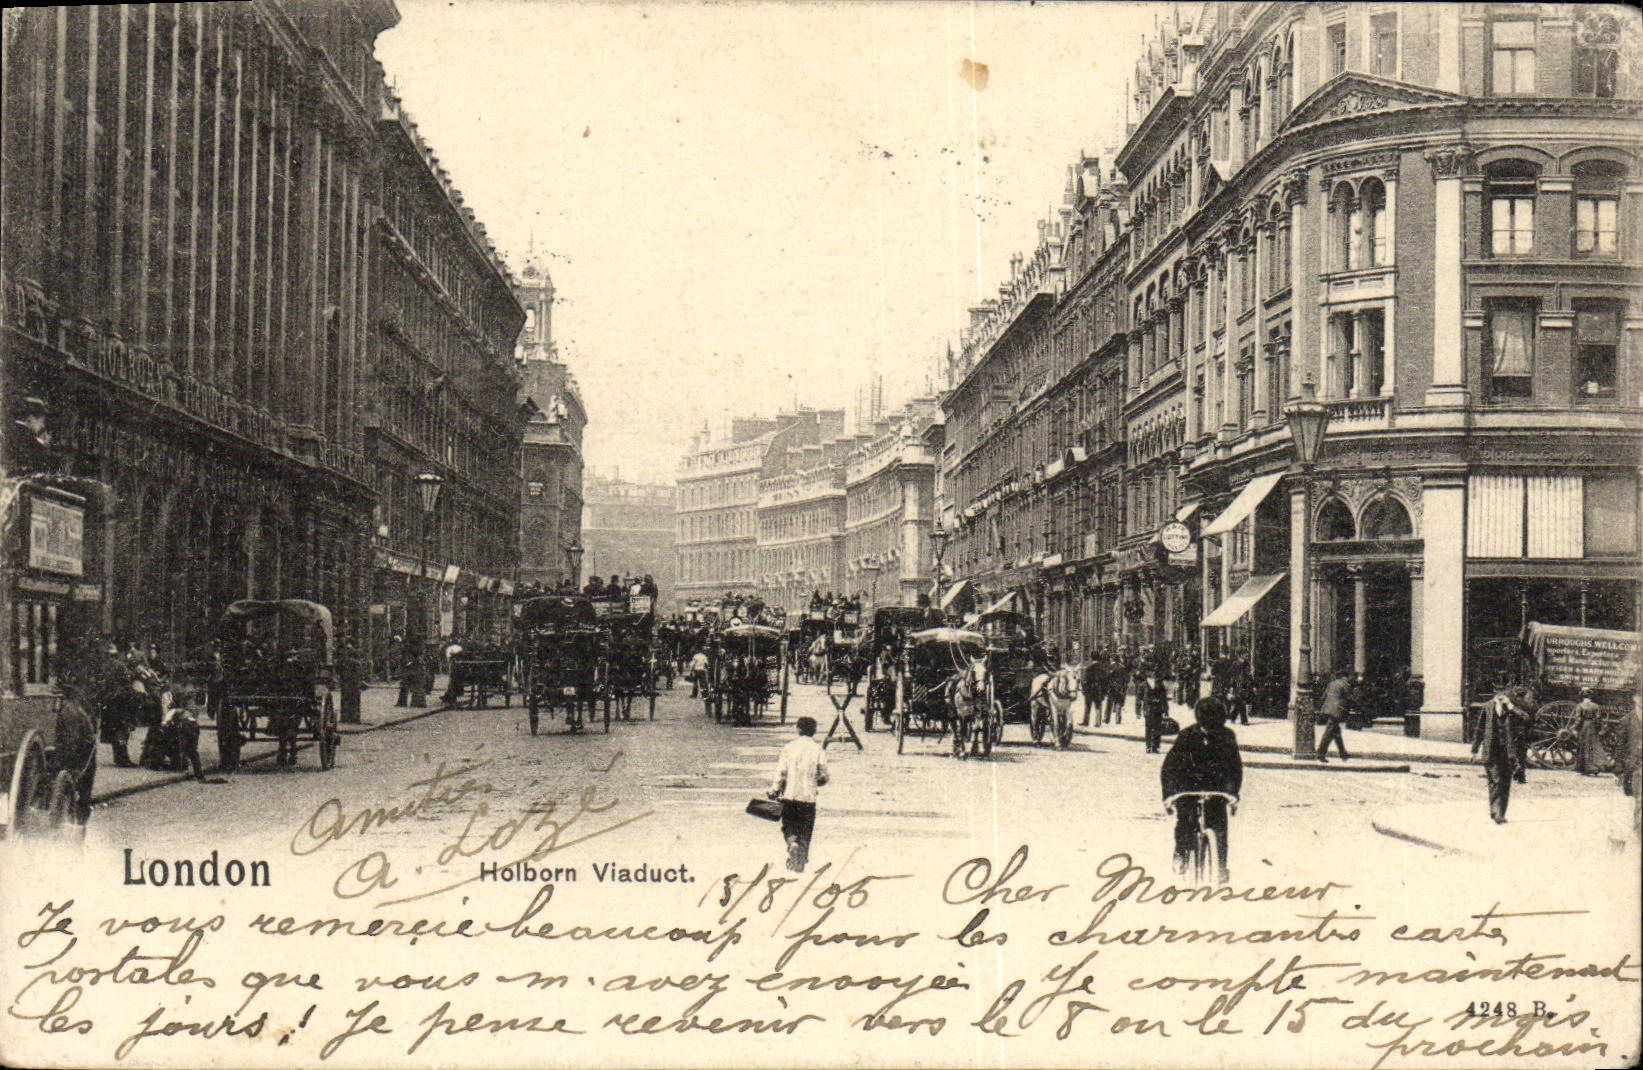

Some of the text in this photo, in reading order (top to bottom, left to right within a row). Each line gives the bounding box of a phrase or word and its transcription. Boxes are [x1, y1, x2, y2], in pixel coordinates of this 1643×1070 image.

[943, 845, 1069, 905] Cher
[18, 899, 74, 947] Je
[99, 914, 225, 936] vous
[484, 884, 747, 962] beaucoup
[777, 907, 919, 972] pour
[937, 909, 1009, 947] les
[8, 985, 93, 1033] les
[320, 1001, 393, 1060] Je
[408, 1002, 586, 1054] pense
[603, 996, 826, 1035] revenir
[851, 1014, 946, 1036] vers
[971, 979, 1021, 1036] le
[1056, 1001, 1110, 1040] 8
[1110, 1016, 1172, 1036] ou
[1184, 994, 1243, 1035] le
[1263, 997, 1355, 1035] 15
[1342, 1000, 1432, 1028] du
[15, 928, 216, 1004] postales
[234, 973, 323, 1016] que
[357, 971, 480, 991] vous
[1019, 950, 1095, 1029] Je
[1128, 955, 1360, 1014] compte
